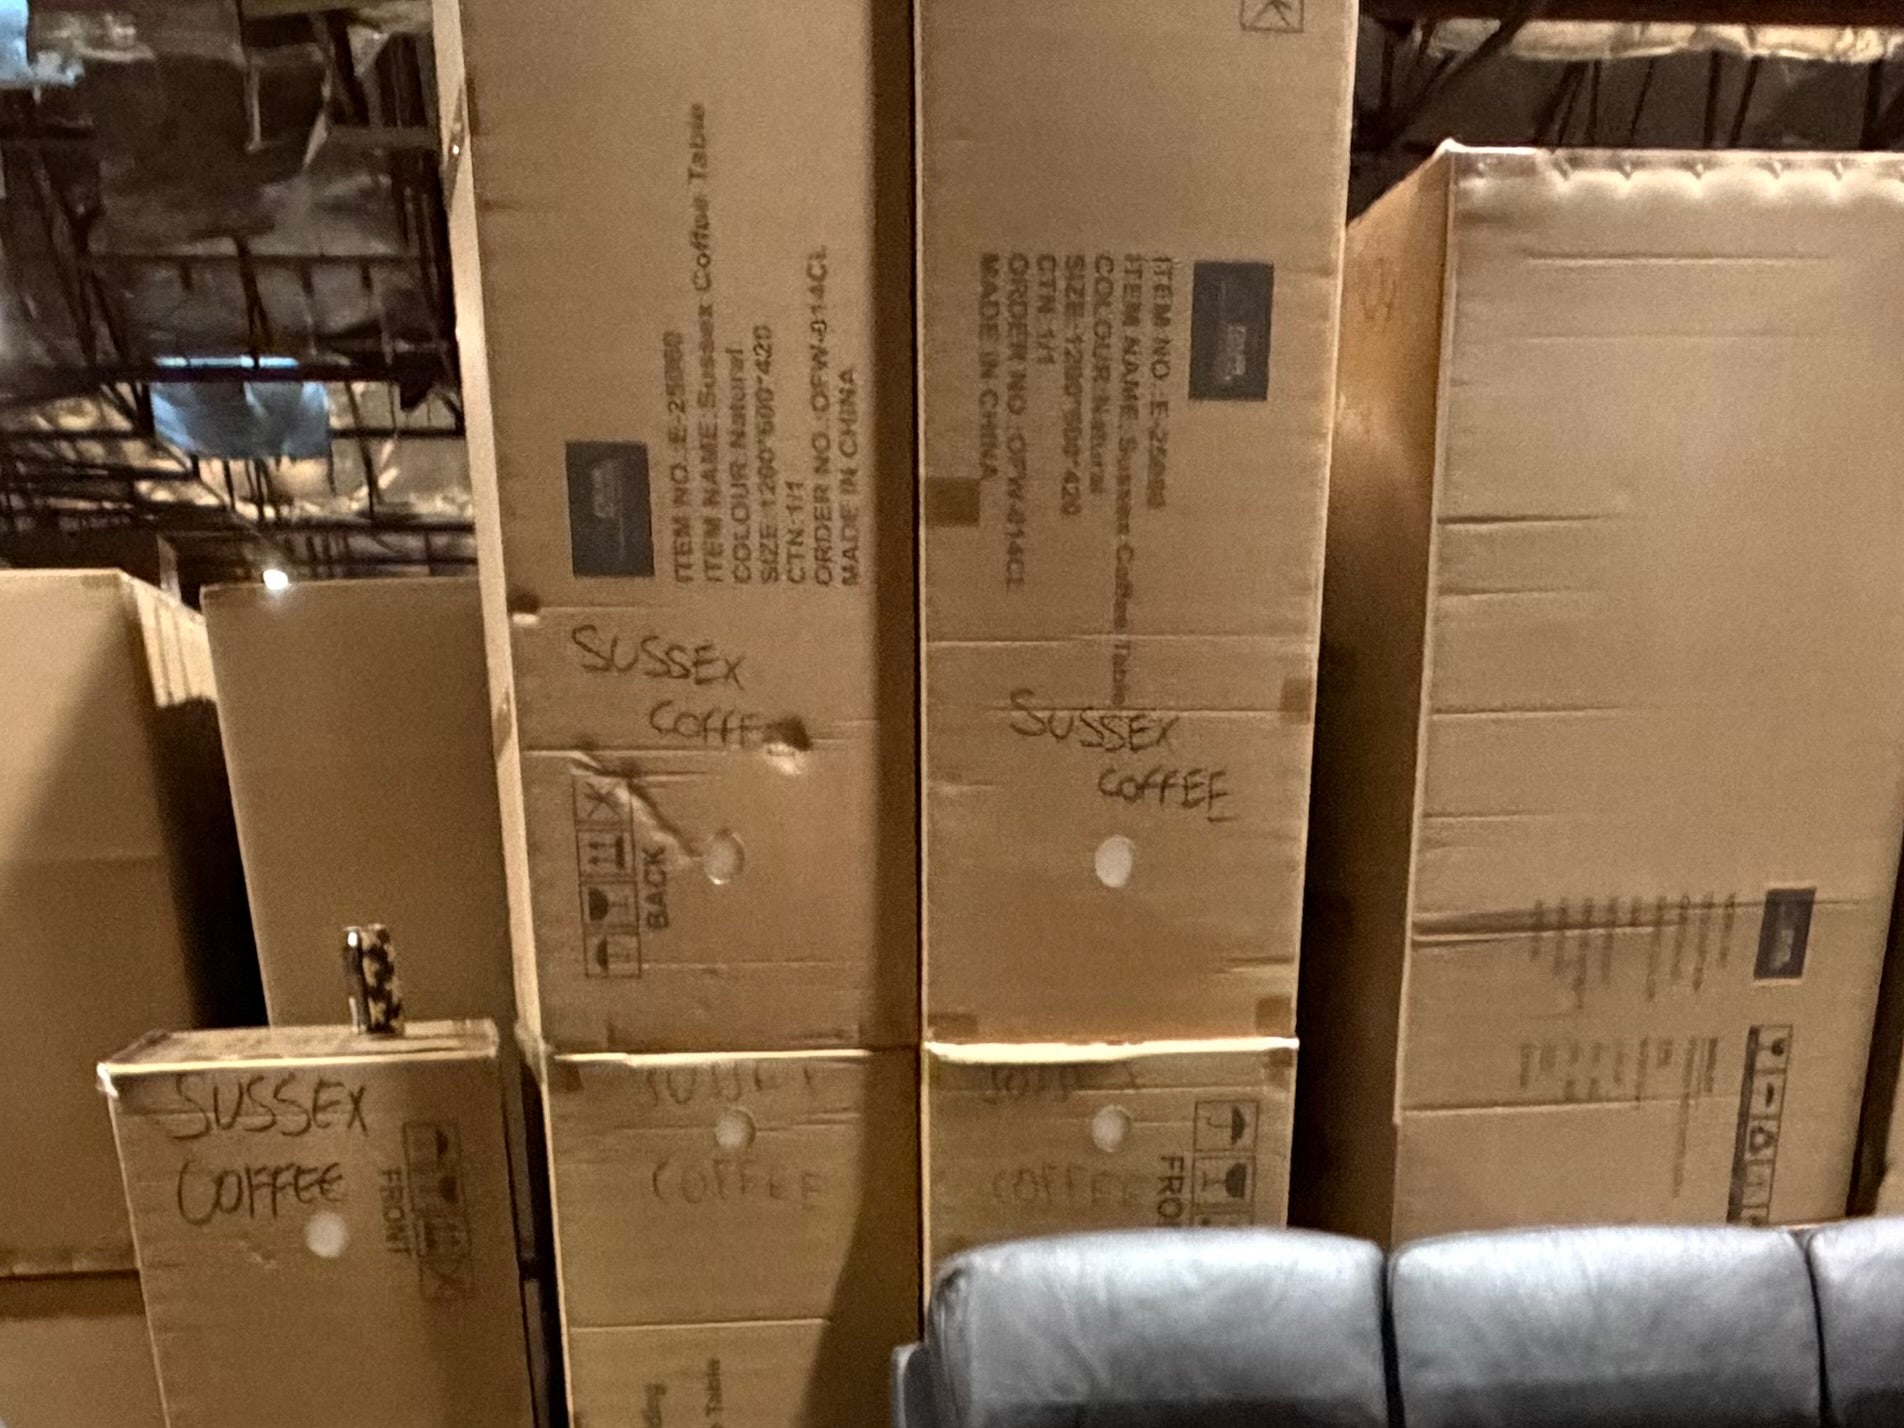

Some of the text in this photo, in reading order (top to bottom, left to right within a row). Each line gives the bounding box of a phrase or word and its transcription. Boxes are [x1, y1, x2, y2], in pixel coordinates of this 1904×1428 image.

[685, 101, 708, 186] Table
[687, 192, 711, 293] Coffee
[1007, 251, 1030, 362] ORDER
[1122, 254, 1143, 327] ITEM
[1153, 255, 1174, 327] ITEM
[978, 252, 1001, 481] MADE IN CHINA
[838, 367, 860, 587] MADE IN CHINA
[672, 517, 694, 584] ITEM
[702, 517, 724, 584] ITEM
[812, 483, 833, 587] ORDER
[570, 623, 748, 692] SUSSEX
[1008, 686, 1181, 756] SUSSEX
[1096, 764, 1239, 825] COFFEE
[642, 845, 671, 930] BACK
[165, 1071, 369, 1142] SUSSEX
[176, 1158, 347, 1226] COFFEE
[377, 1166, 412, 1257] FRONT
